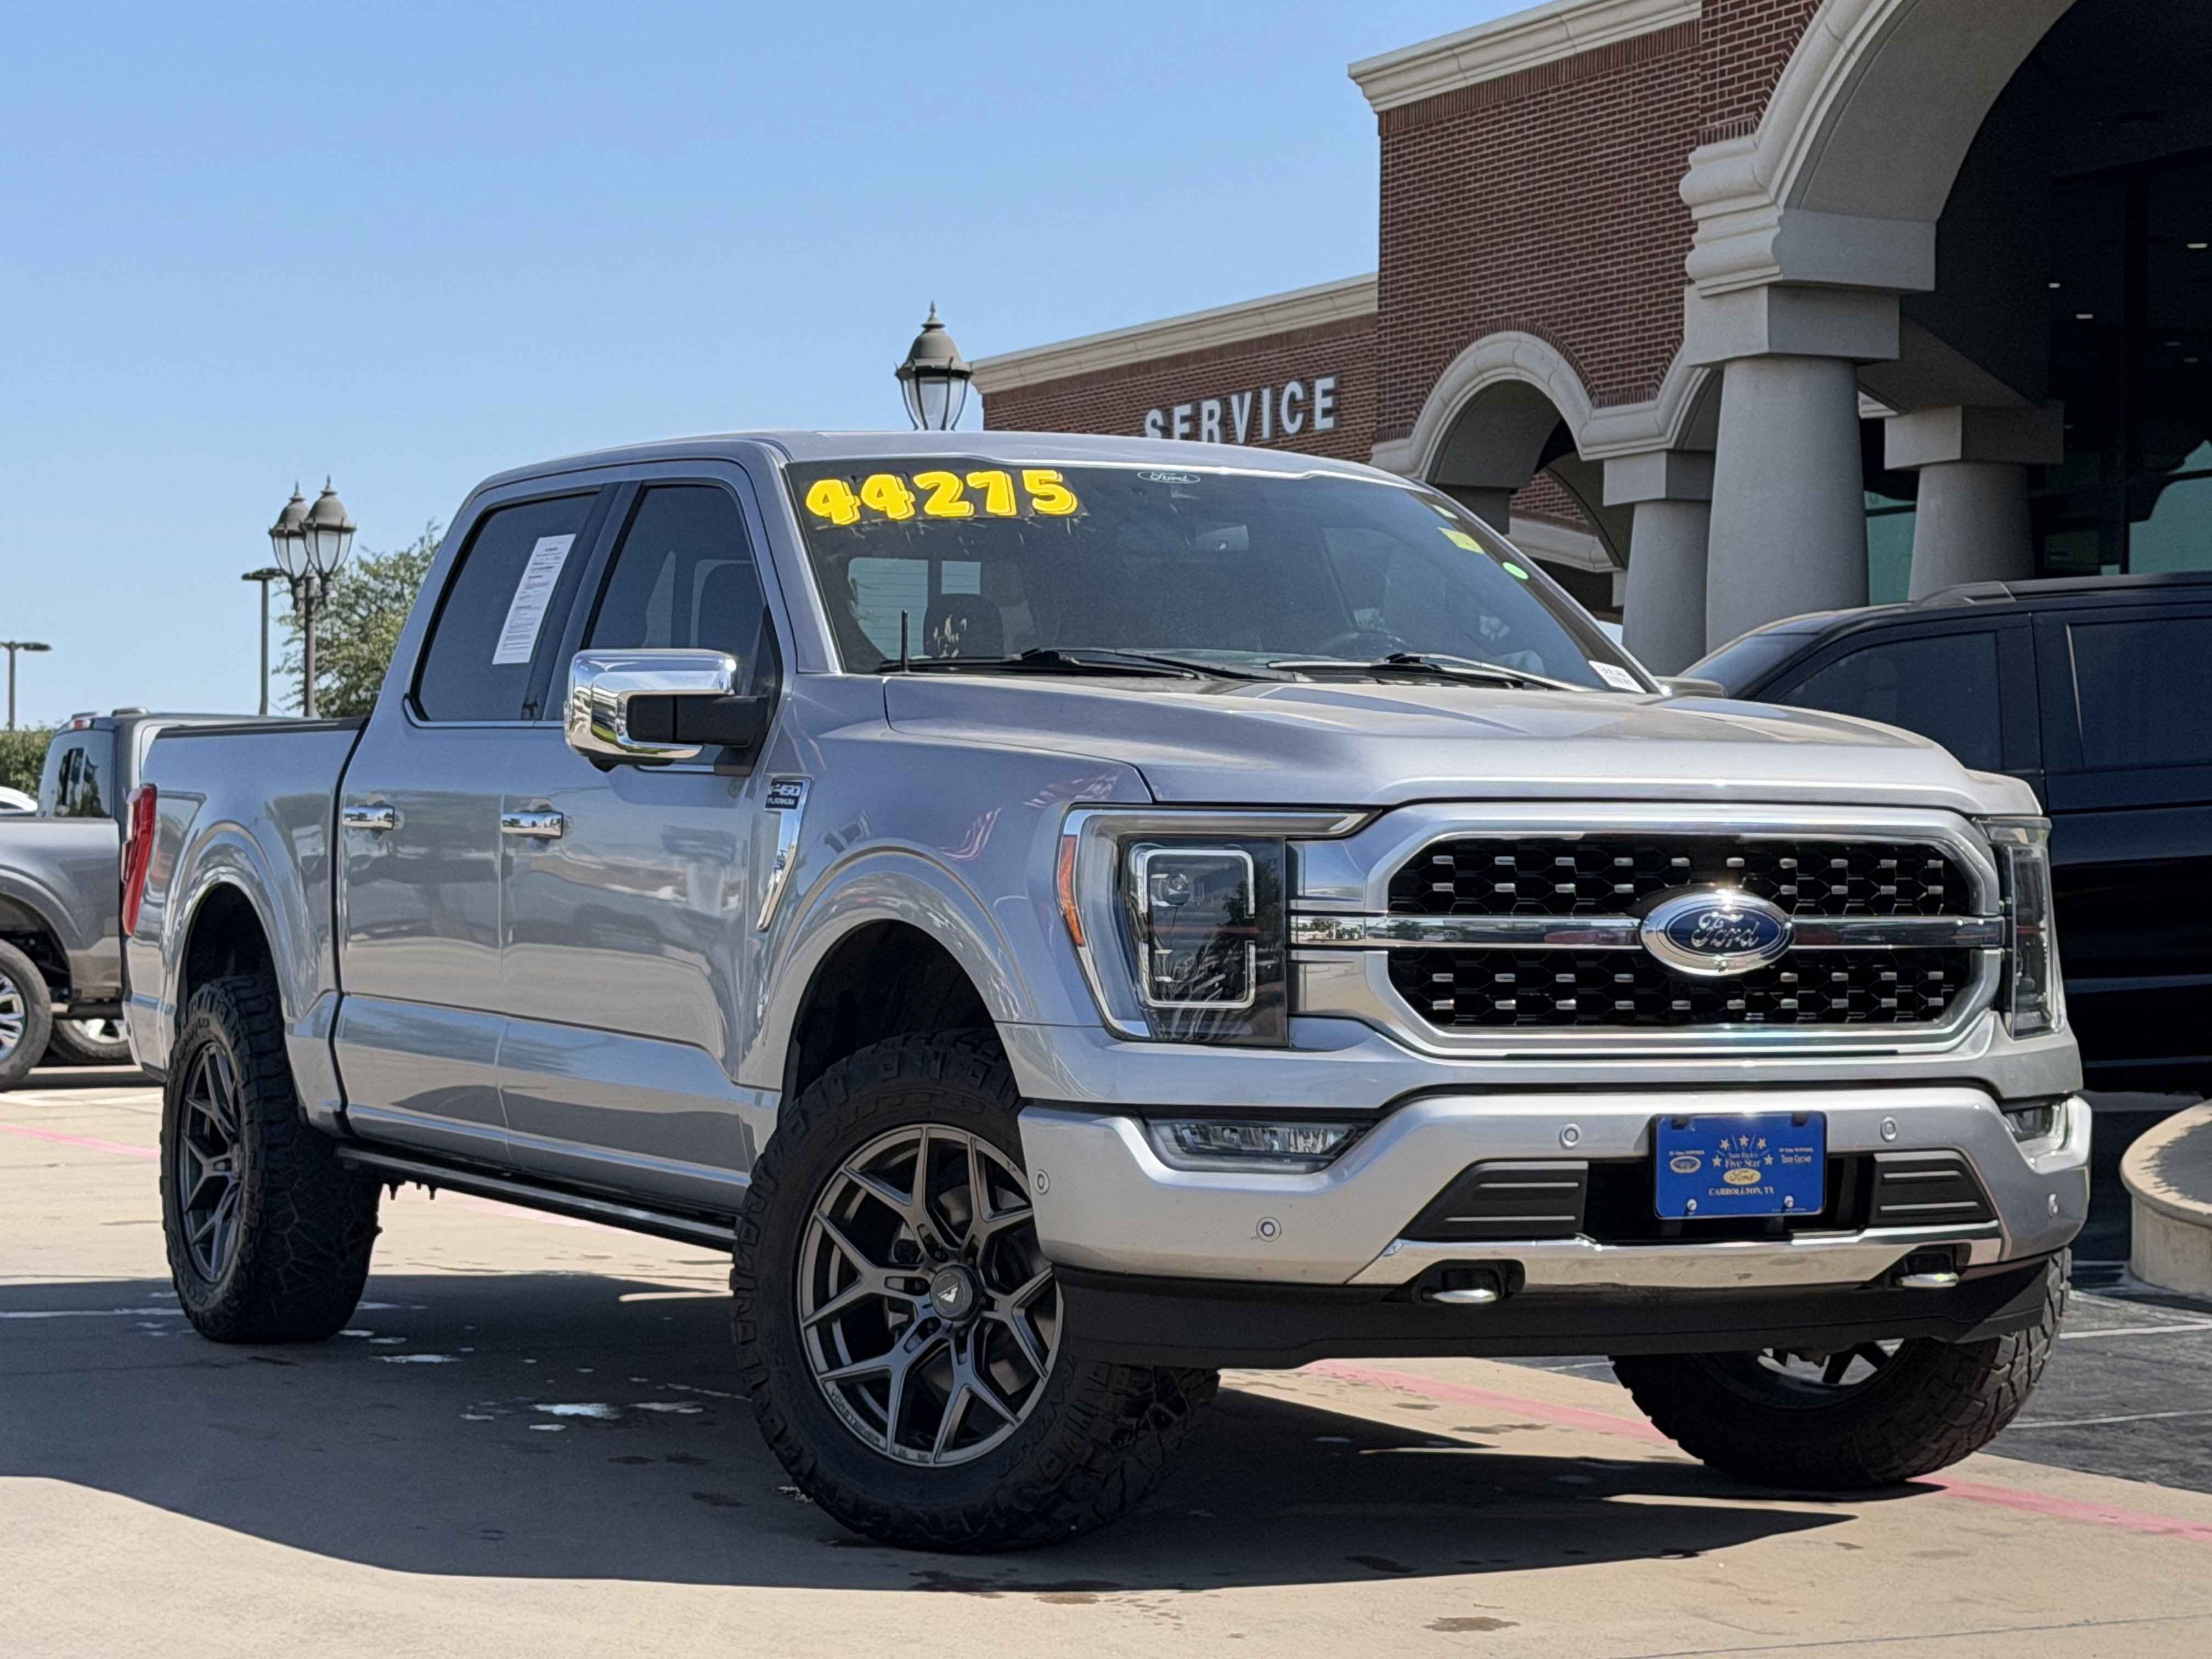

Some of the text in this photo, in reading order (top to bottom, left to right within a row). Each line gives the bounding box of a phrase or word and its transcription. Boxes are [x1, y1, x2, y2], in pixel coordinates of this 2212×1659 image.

[1145, 376, 1336, 443] SERVICE
[806, 470, 1077, 525] 44275
[1690, 911, 1760, 948] Ford
[1725, 1158, 1742, 1168] Five
[1729, 1170, 1756, 1182] Ford
[1764, 1186, 1775, 1194] TX
